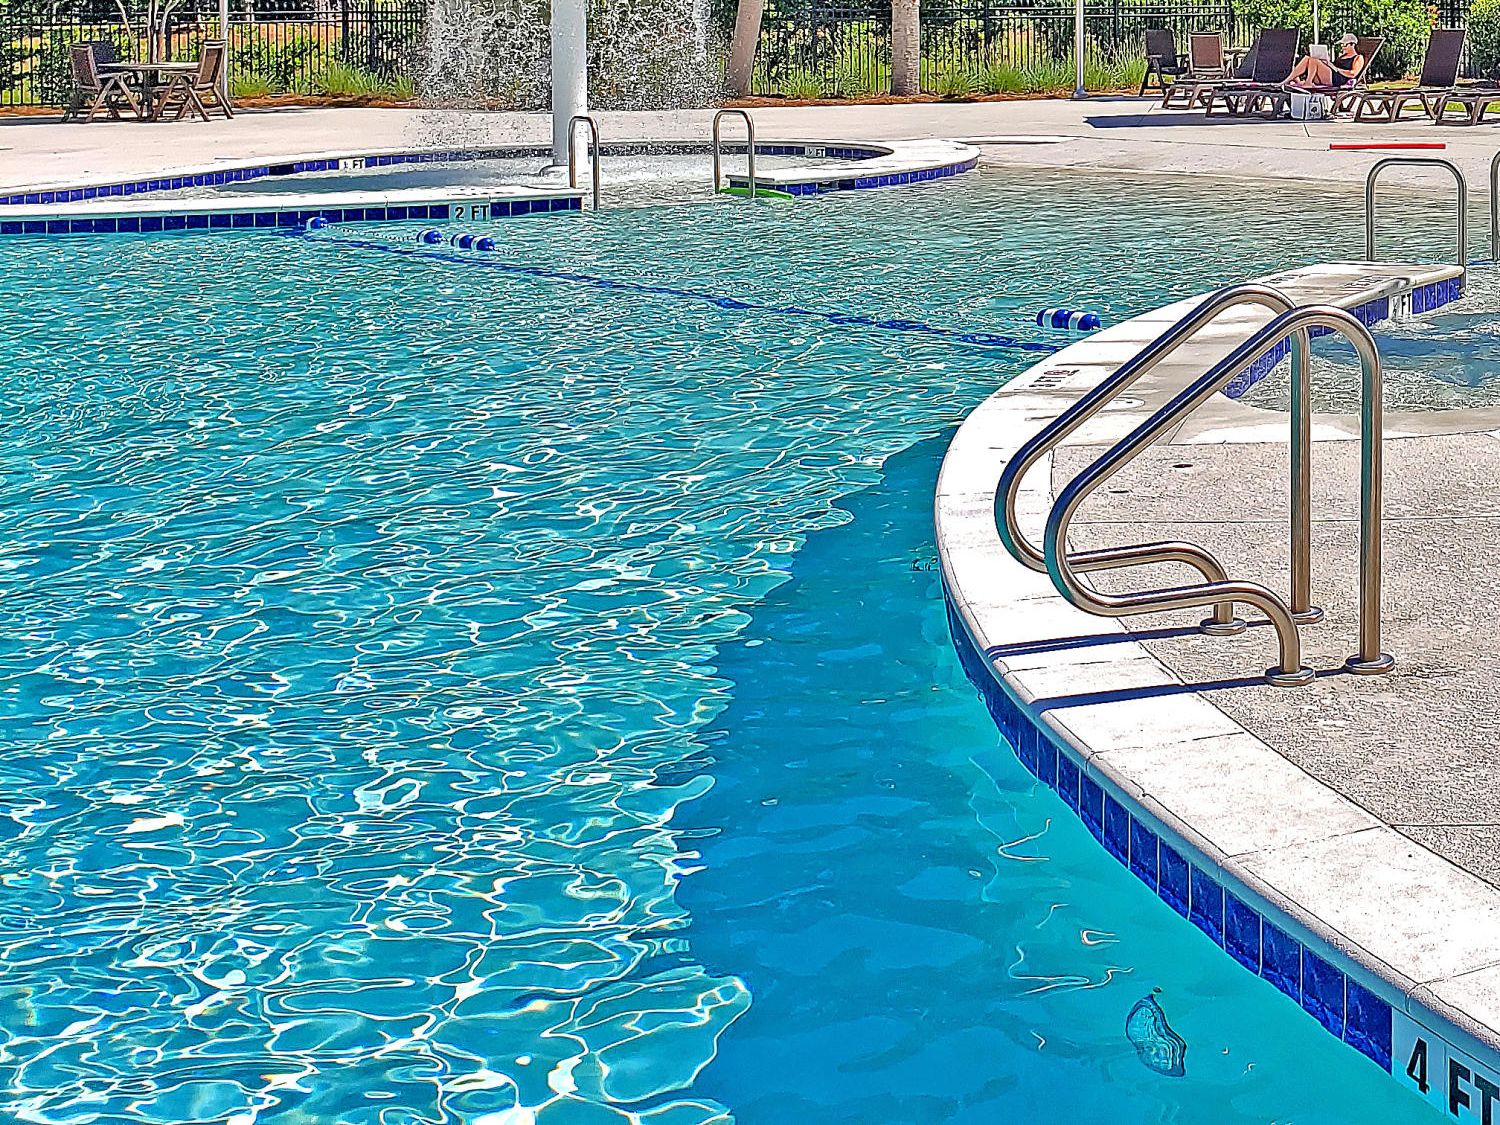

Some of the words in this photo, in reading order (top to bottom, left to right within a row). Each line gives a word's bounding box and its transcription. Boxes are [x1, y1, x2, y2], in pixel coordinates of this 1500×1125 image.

[352, 159, 364, 169] FT
[455, 206, 465, 219] 2
[471, 205, 489, 220] FT
[1401, 292, 1412, 315] FT
[1406, 1036, 1430, 1095] 4
[1449, 1056, 1500, 1125] FT
